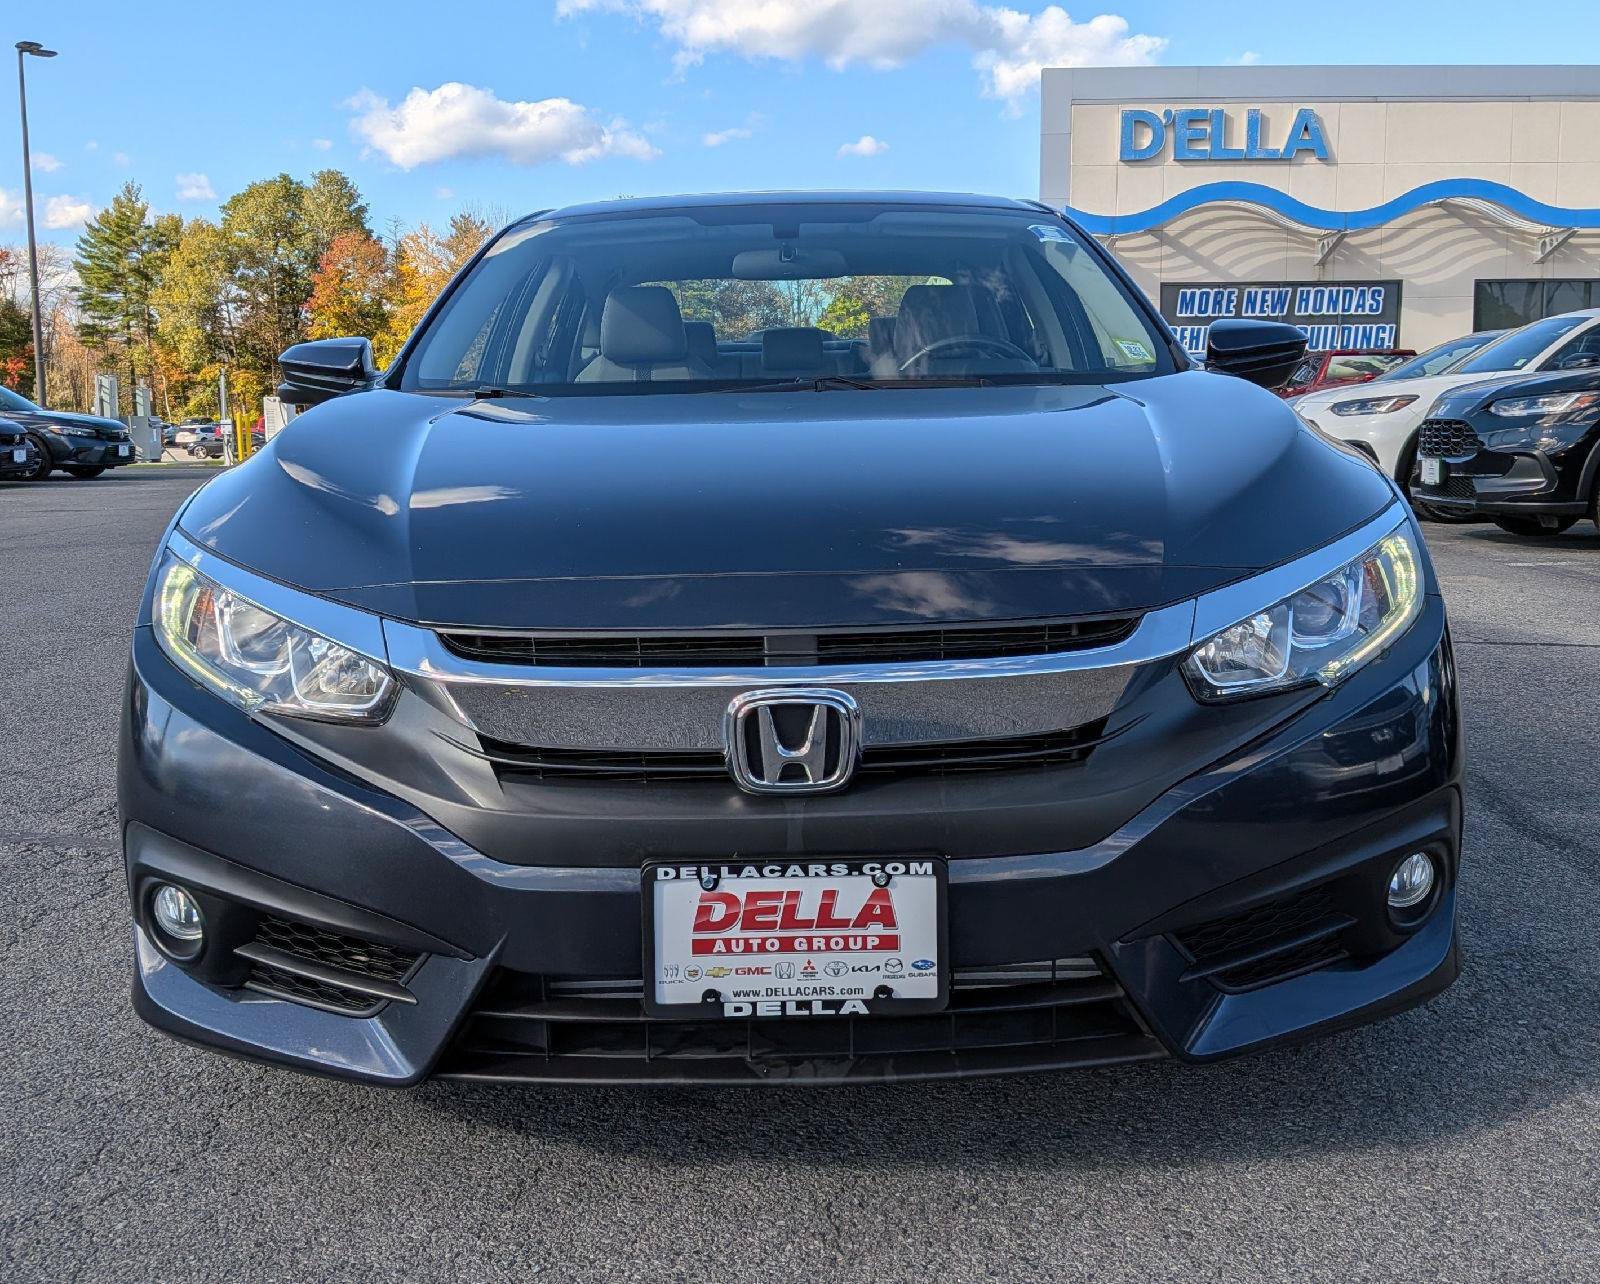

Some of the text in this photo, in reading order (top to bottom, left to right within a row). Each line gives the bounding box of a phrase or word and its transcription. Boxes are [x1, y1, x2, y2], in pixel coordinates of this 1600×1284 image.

[1119, 108, 1328, 161] D'ELLA
[1177, 286, 1385, 317] MORE NEW HONDAS
[1169, 326, 1209, 353] EHI
[656, 861, 933, 880] DELLACARS.COM
[692, 887, 899, 934] DELLA
[712, 936, 880, 953] AUTO GROUP
[735, 966, 772, 976] GMC
[732, 985, 864, 998] www.DELLACARS.com
[723, 1000, 870, 1017] DELLA
